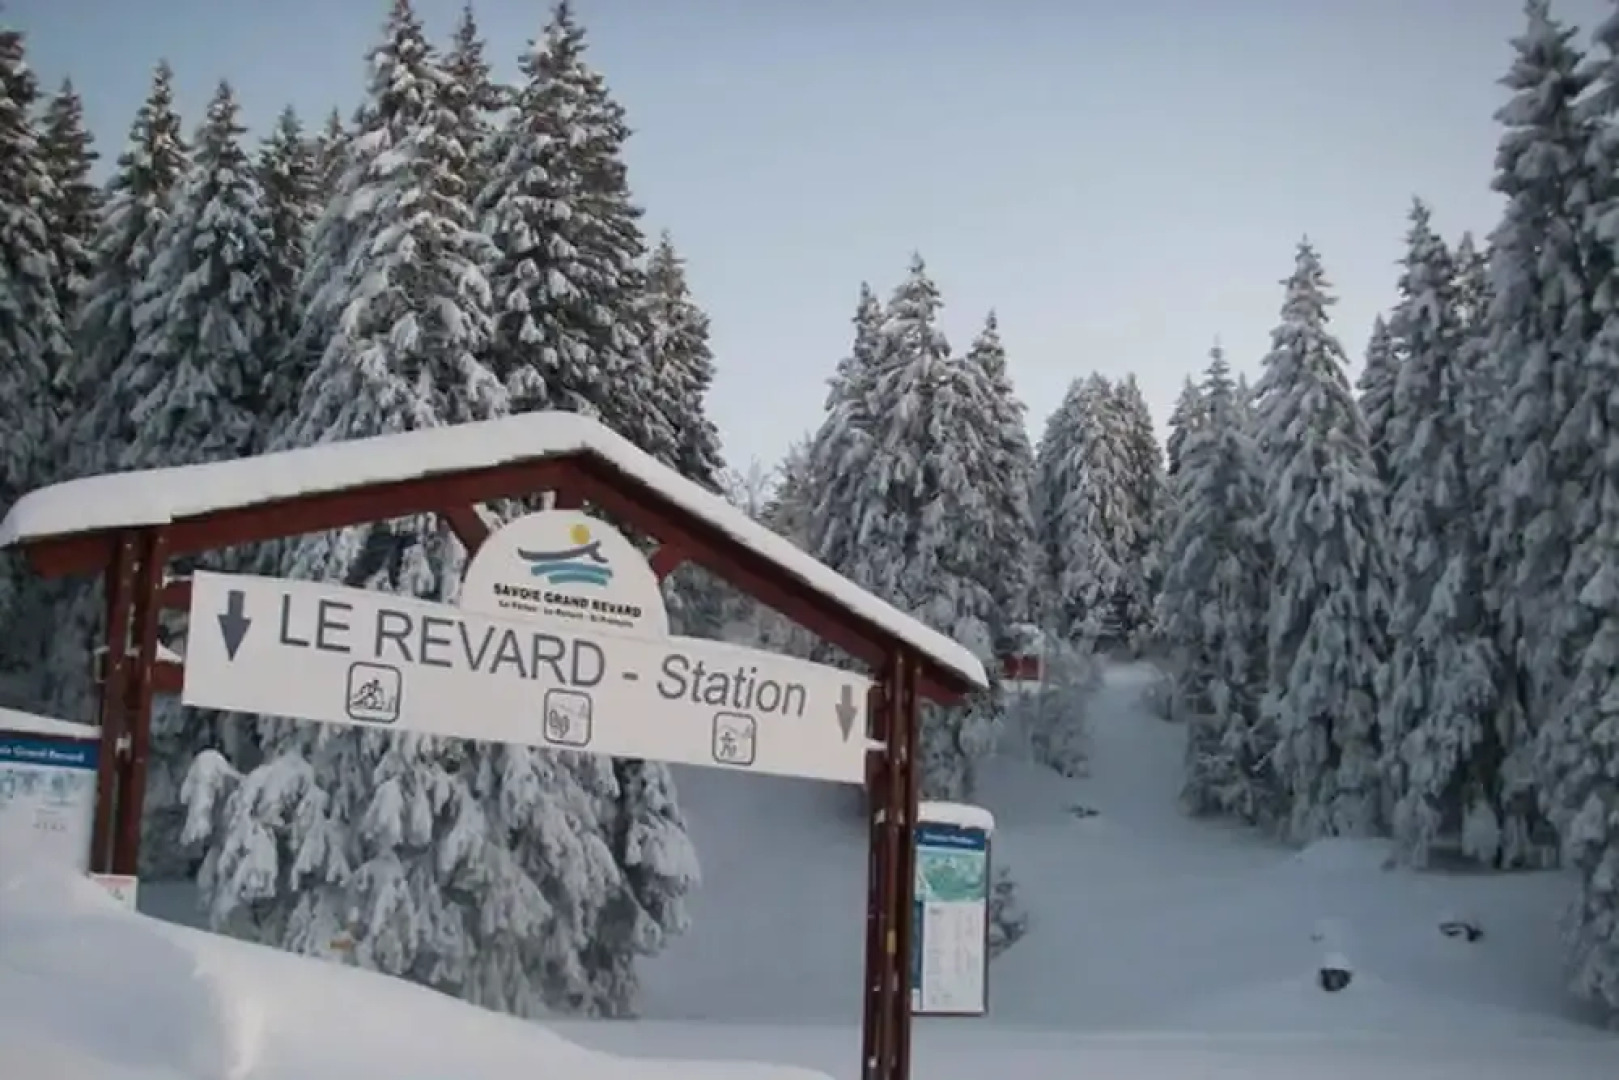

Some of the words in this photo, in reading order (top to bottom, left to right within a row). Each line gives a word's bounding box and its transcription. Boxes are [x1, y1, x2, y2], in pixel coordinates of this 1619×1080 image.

[493, 583, 541, 600] SAVOIE
[543, 591, 589, 608] GRAND
[592, 599, 642, 617] REVARD
[280, 594, 352, 653] LE
[375, 609, 606, 689] REVARD
[656, 654, 806, 718] Station
